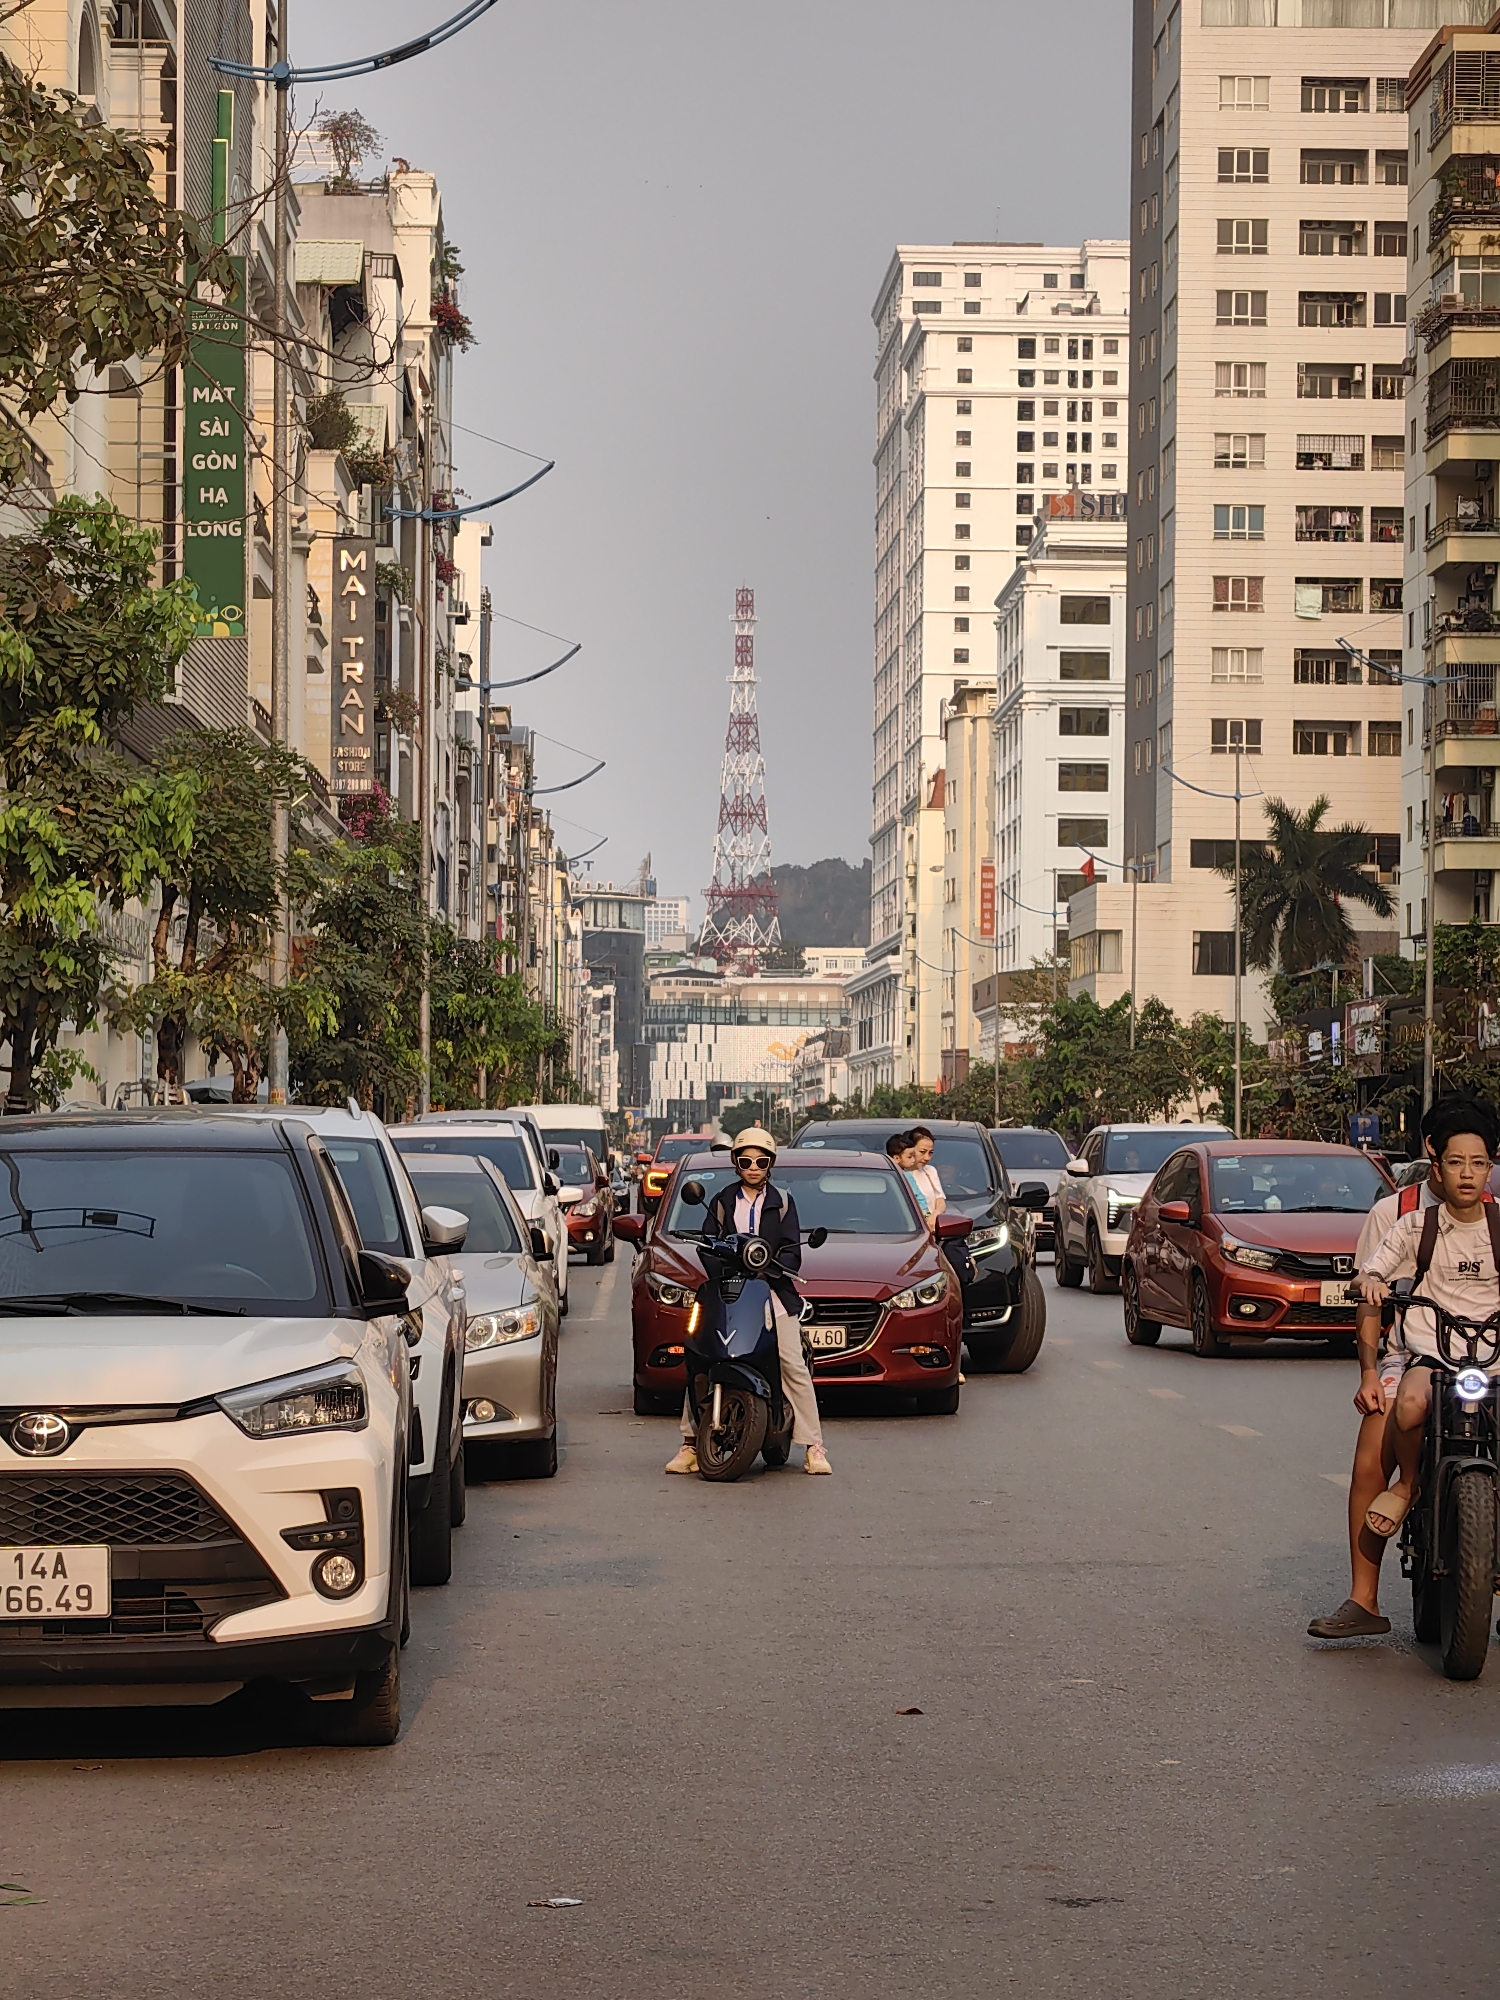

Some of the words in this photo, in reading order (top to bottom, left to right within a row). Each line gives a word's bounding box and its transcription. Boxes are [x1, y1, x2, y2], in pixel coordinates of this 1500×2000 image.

[199, 416, 230, 437] SÀI
[192, 450, 237, 470] GÒN
[200, 487, 229, 508] HẠ
[187, 520, 242, 537] LONG
[340, 550, 366, 621] MAI
[340, 637, 364, 735] TRAN
[332, 747, 371, 758] FASHION
[338, 761, 366, 772] STORE
[807, 1330, 843, 1346] 4.60
[14, 1552, 68, 1580] 14A
[0, 1584, 92, 1613] 66.49
